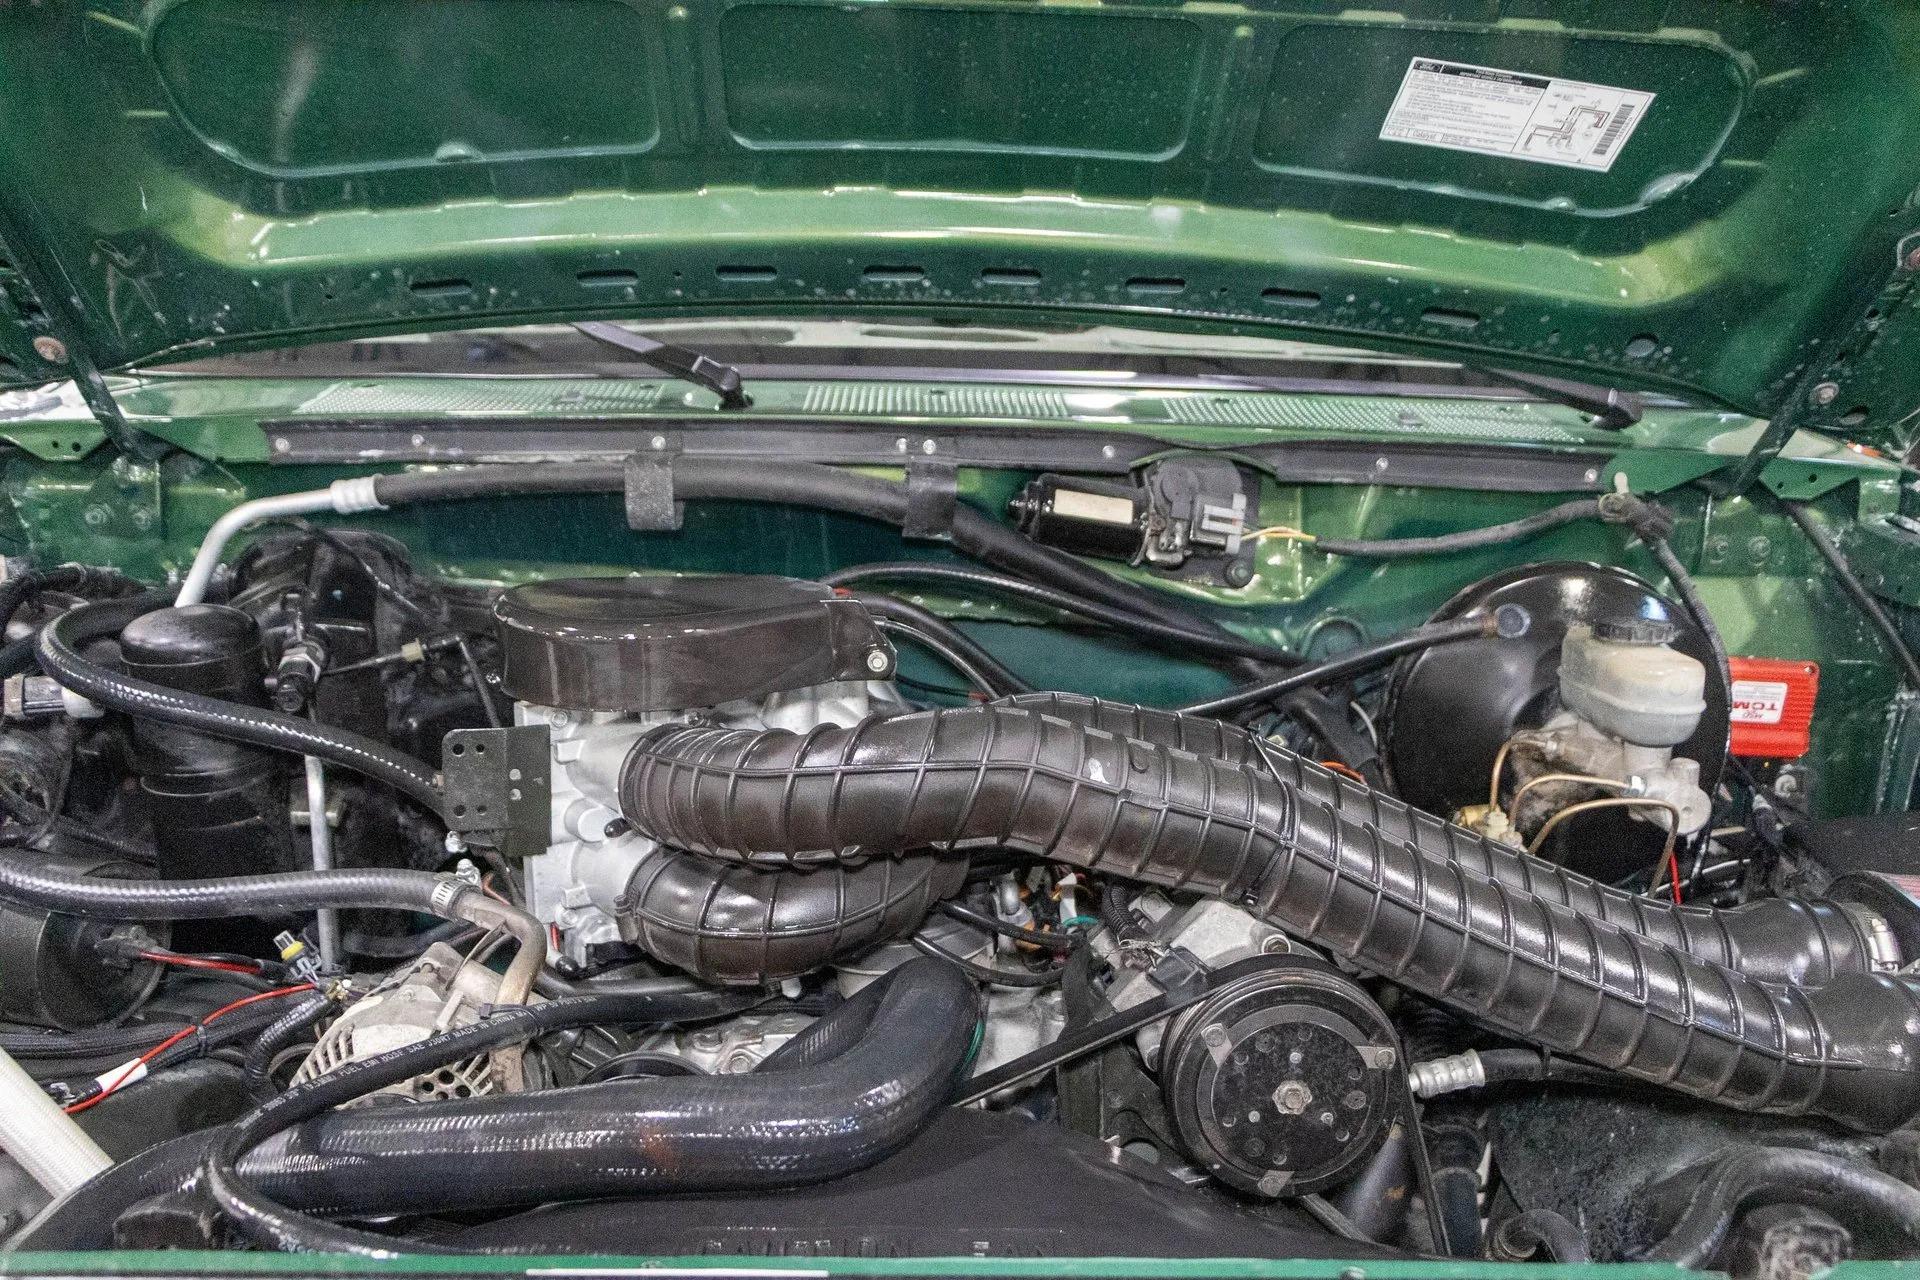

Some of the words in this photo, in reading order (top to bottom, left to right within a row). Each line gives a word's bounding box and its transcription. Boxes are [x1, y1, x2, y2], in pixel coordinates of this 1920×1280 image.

[1733, 701, 1778, 711] TCM
[339, 1066, 363, 1077] FUEL
[407, 1043, 427, 1054] SAE
[453, 1027, 478, 1038] MADE
[478, 1021, 490, 1031] IN
[492, 1013, 516, 1027] CHINA
